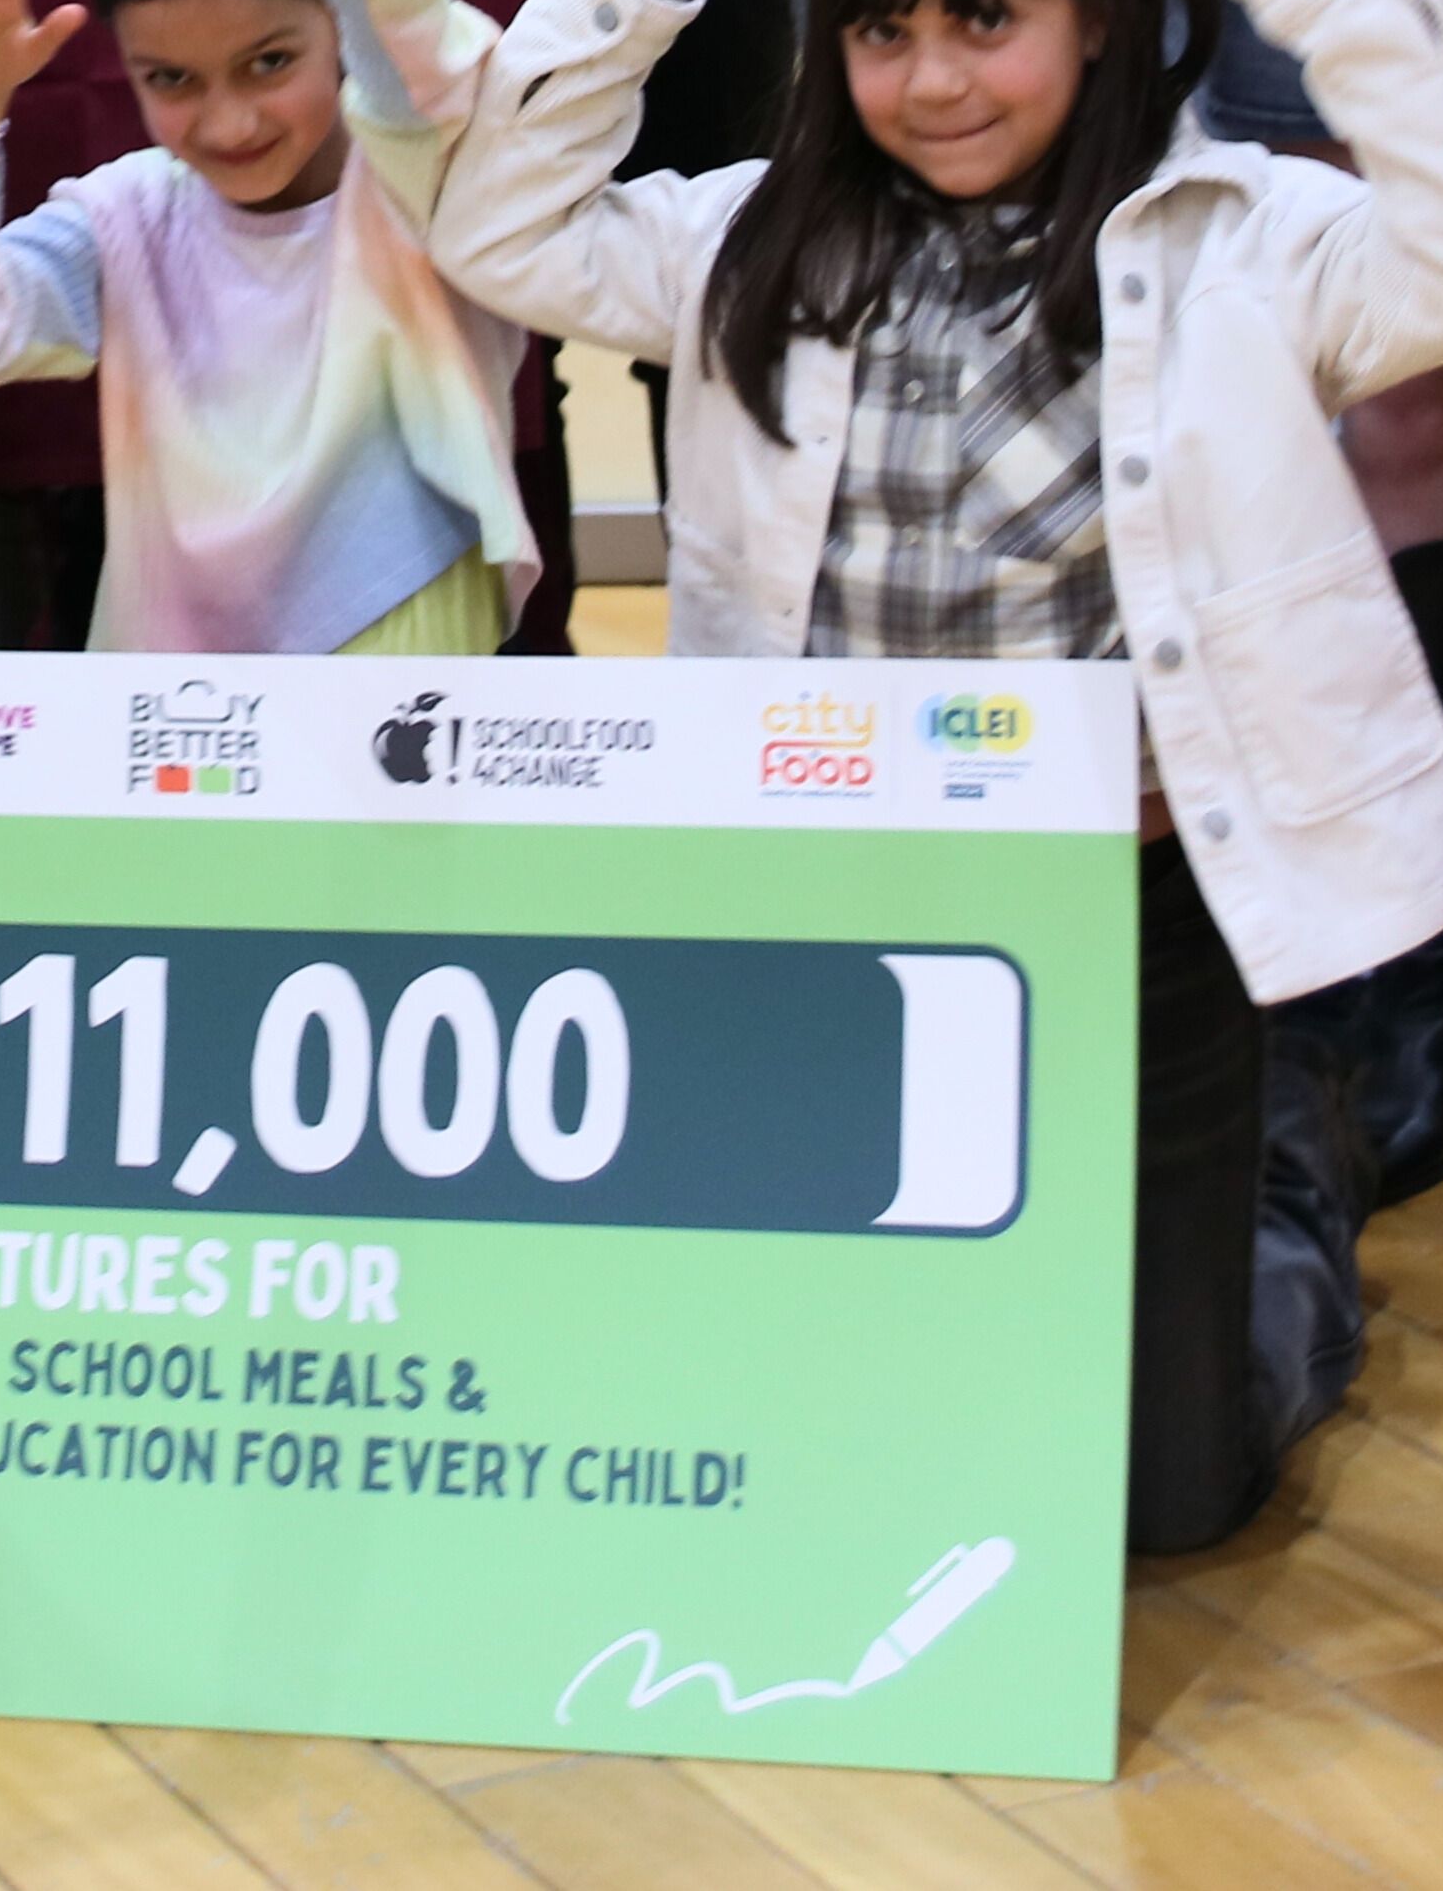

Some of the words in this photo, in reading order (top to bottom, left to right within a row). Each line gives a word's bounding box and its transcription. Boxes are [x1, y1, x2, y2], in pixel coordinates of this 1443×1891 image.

[473, 718, 655, 751] SCHOOLFOOD
[929, 708, 1016, 737] ICLEI
[129, 729, 260, 759] BETTER
[472, 755, 603, 787] 4CHANGE
[249, 1239, 401, 1324] FOR
[10, 1338, 223, 1402] SCHOOL
[242, 1348, 428, 1411] MEALS
[446, 1357, 486, 1413] &
[233, 1430, 341, 1490] FOR
[361, 1436, 548, 1500] EVERY
[566, 1446, 747, 1510] CHILD!
